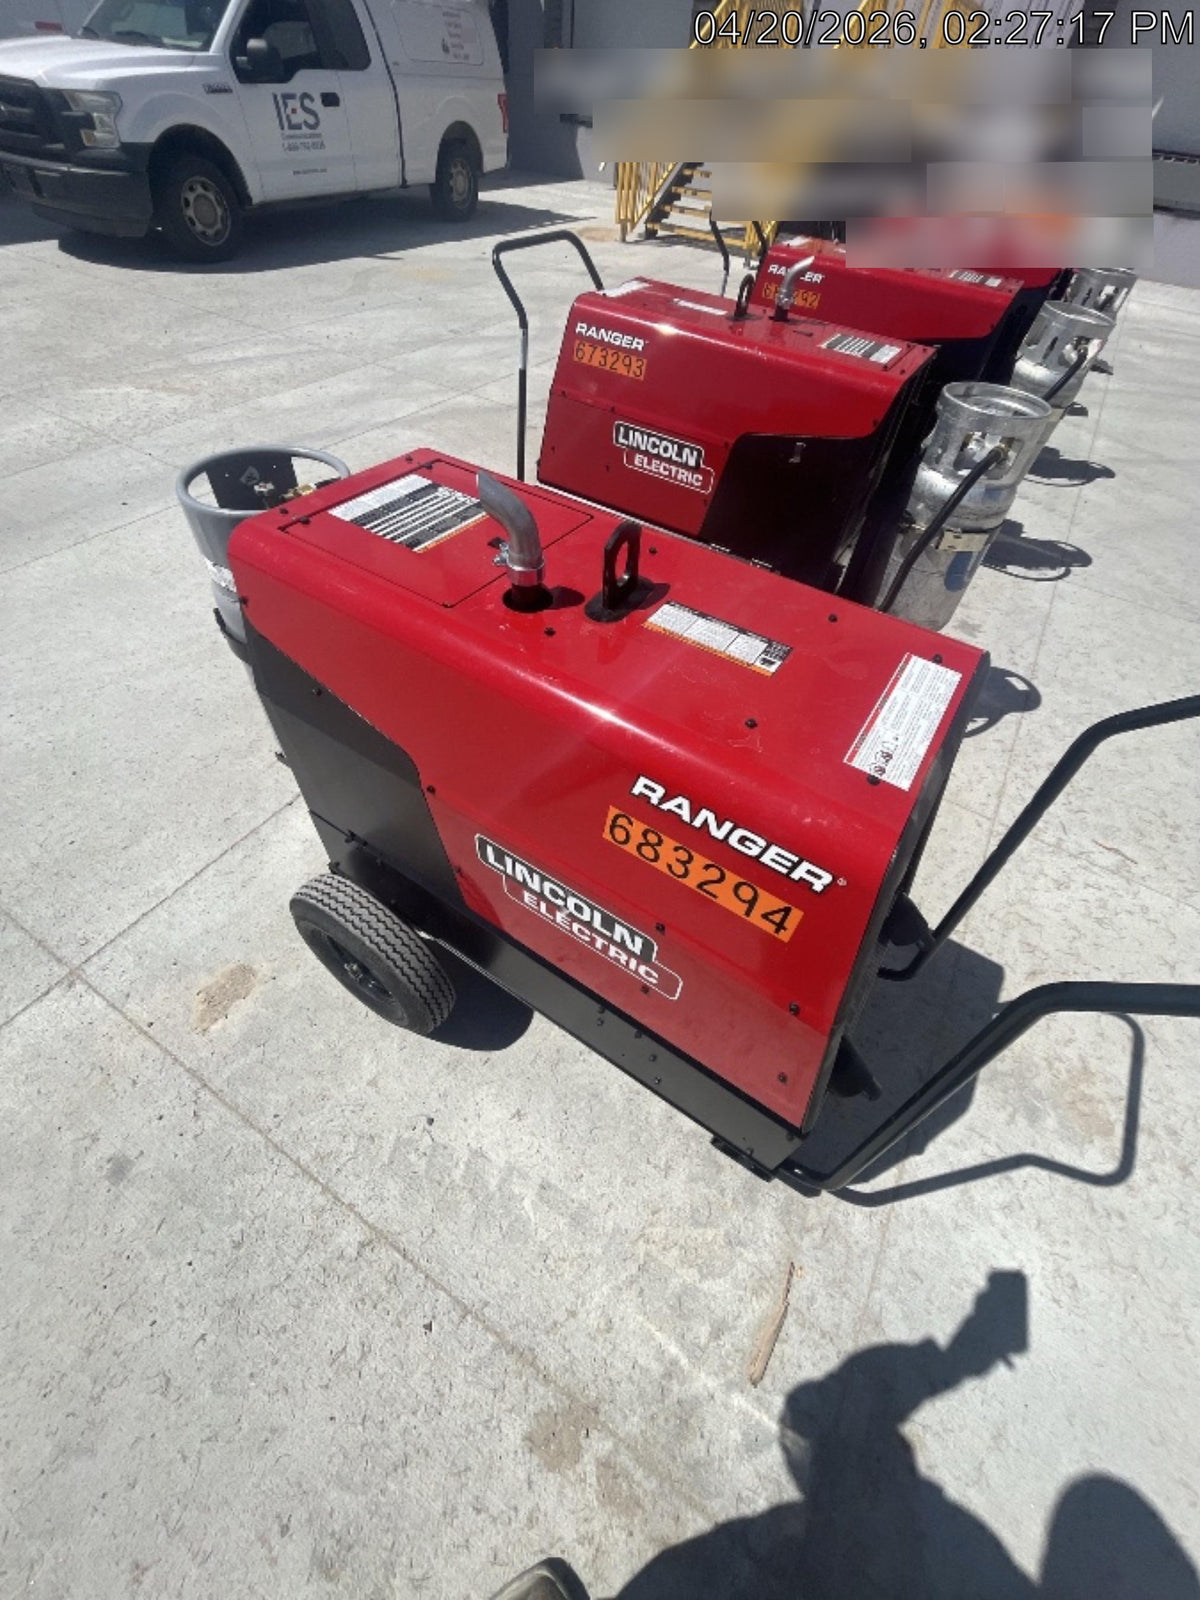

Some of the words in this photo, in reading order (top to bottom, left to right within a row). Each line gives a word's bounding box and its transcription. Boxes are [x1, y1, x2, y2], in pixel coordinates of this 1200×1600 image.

[272, 92, 320, 130] IES
[768, 264, 823, 284] RAER
[575, 322, 644, 351] RANGER
[575, 341, 644, 377] 673293
[618, 426, 698, 467] LINCOLN
[634, 453, 703, 486] ELECTRIC
[630, 775, 835, 894] RANGER
[608, 813, 794, 935] 683294
[485, 844, 644, 954] LINCOLN
[523, 892, 660, 985] ELECTRIC
